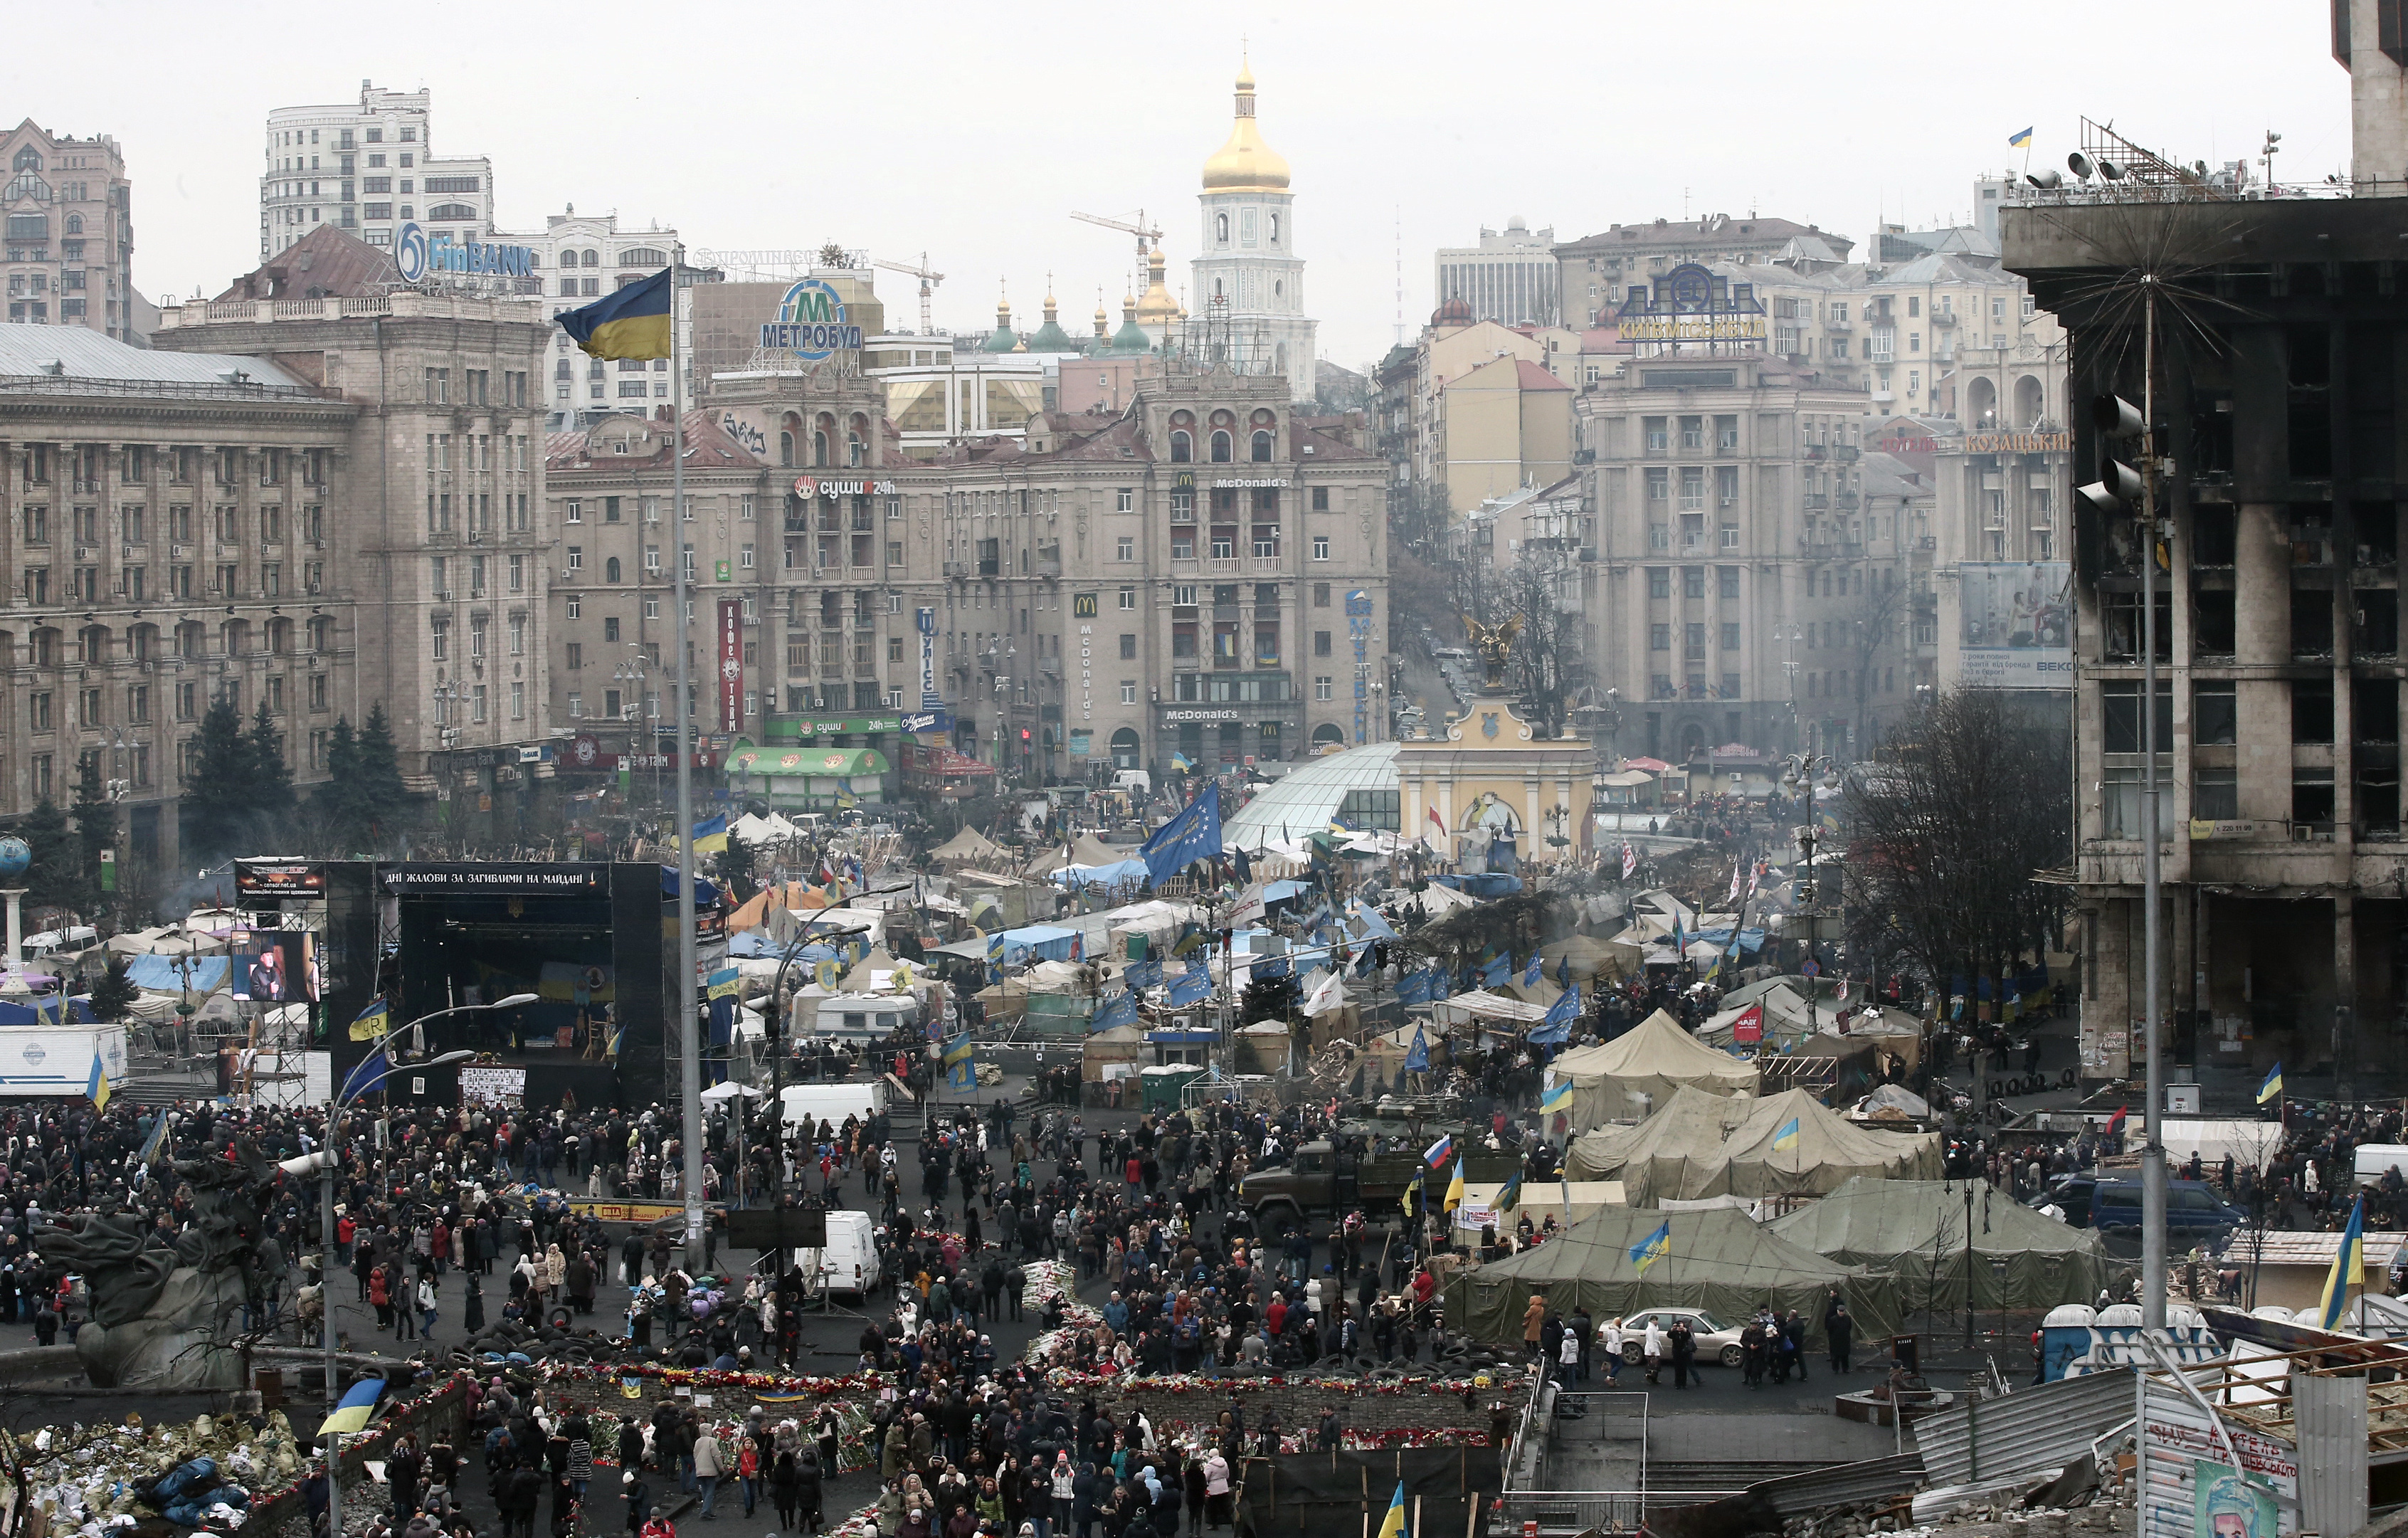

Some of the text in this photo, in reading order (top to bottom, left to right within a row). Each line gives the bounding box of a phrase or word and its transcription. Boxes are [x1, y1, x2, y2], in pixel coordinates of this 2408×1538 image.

[429, 236, 534, 276] FinBANK
[761, 325, 862, 349] МЕТРОБУД
[1881, 436, 1938, 453] ГОТЕЛЬ
[1216, 478, 1288, 488] McDonald's
[1080, 625, 1093, 720] McDonald's
[1166, 710, 1238, 720] McDonald's
[868, 720, 883, 730] 24h
[446, 752, 496, 768] Patinum Bank
[386, 872, 583, 885] ДНІ ЖАЛОБИ ЗА ЗАГИБЛИМИ НА МАЙДАНІ
[603, 1208, 621, 1217] BILLA
[2209, 1426, 2281, 1456] ККТЕЛЬ
[2212, 1445, 2296, 1478] ГРШЕВСЬКОГО
